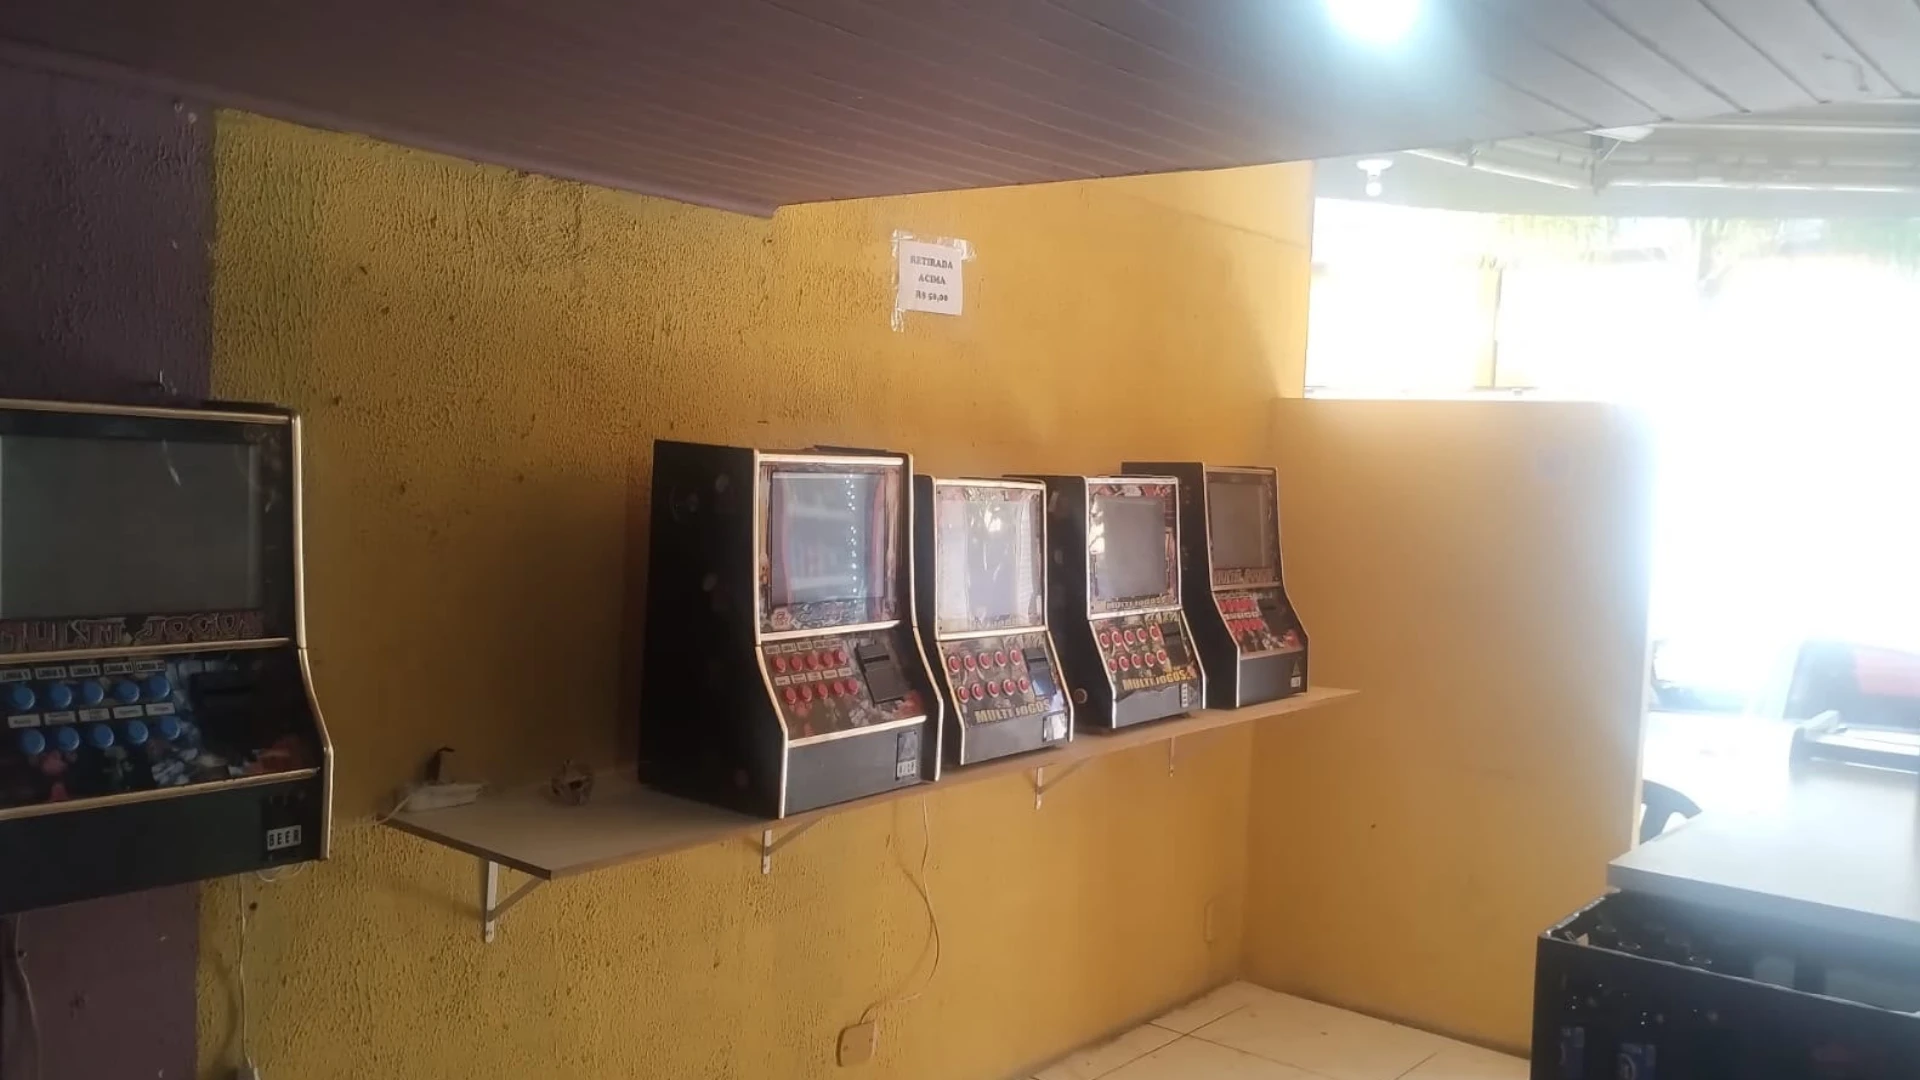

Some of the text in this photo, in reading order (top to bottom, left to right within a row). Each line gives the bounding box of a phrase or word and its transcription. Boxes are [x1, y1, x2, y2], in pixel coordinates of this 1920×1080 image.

[910, 255, 953, 269] RETIRADA
[918, 274, 946, 285] ACIMA
[1122, 669, 1187, 691] MULTI JOGOS
[974, 700, 1051, 723] MULTI JOGOS
[269, 829, 300, 847] BEER
